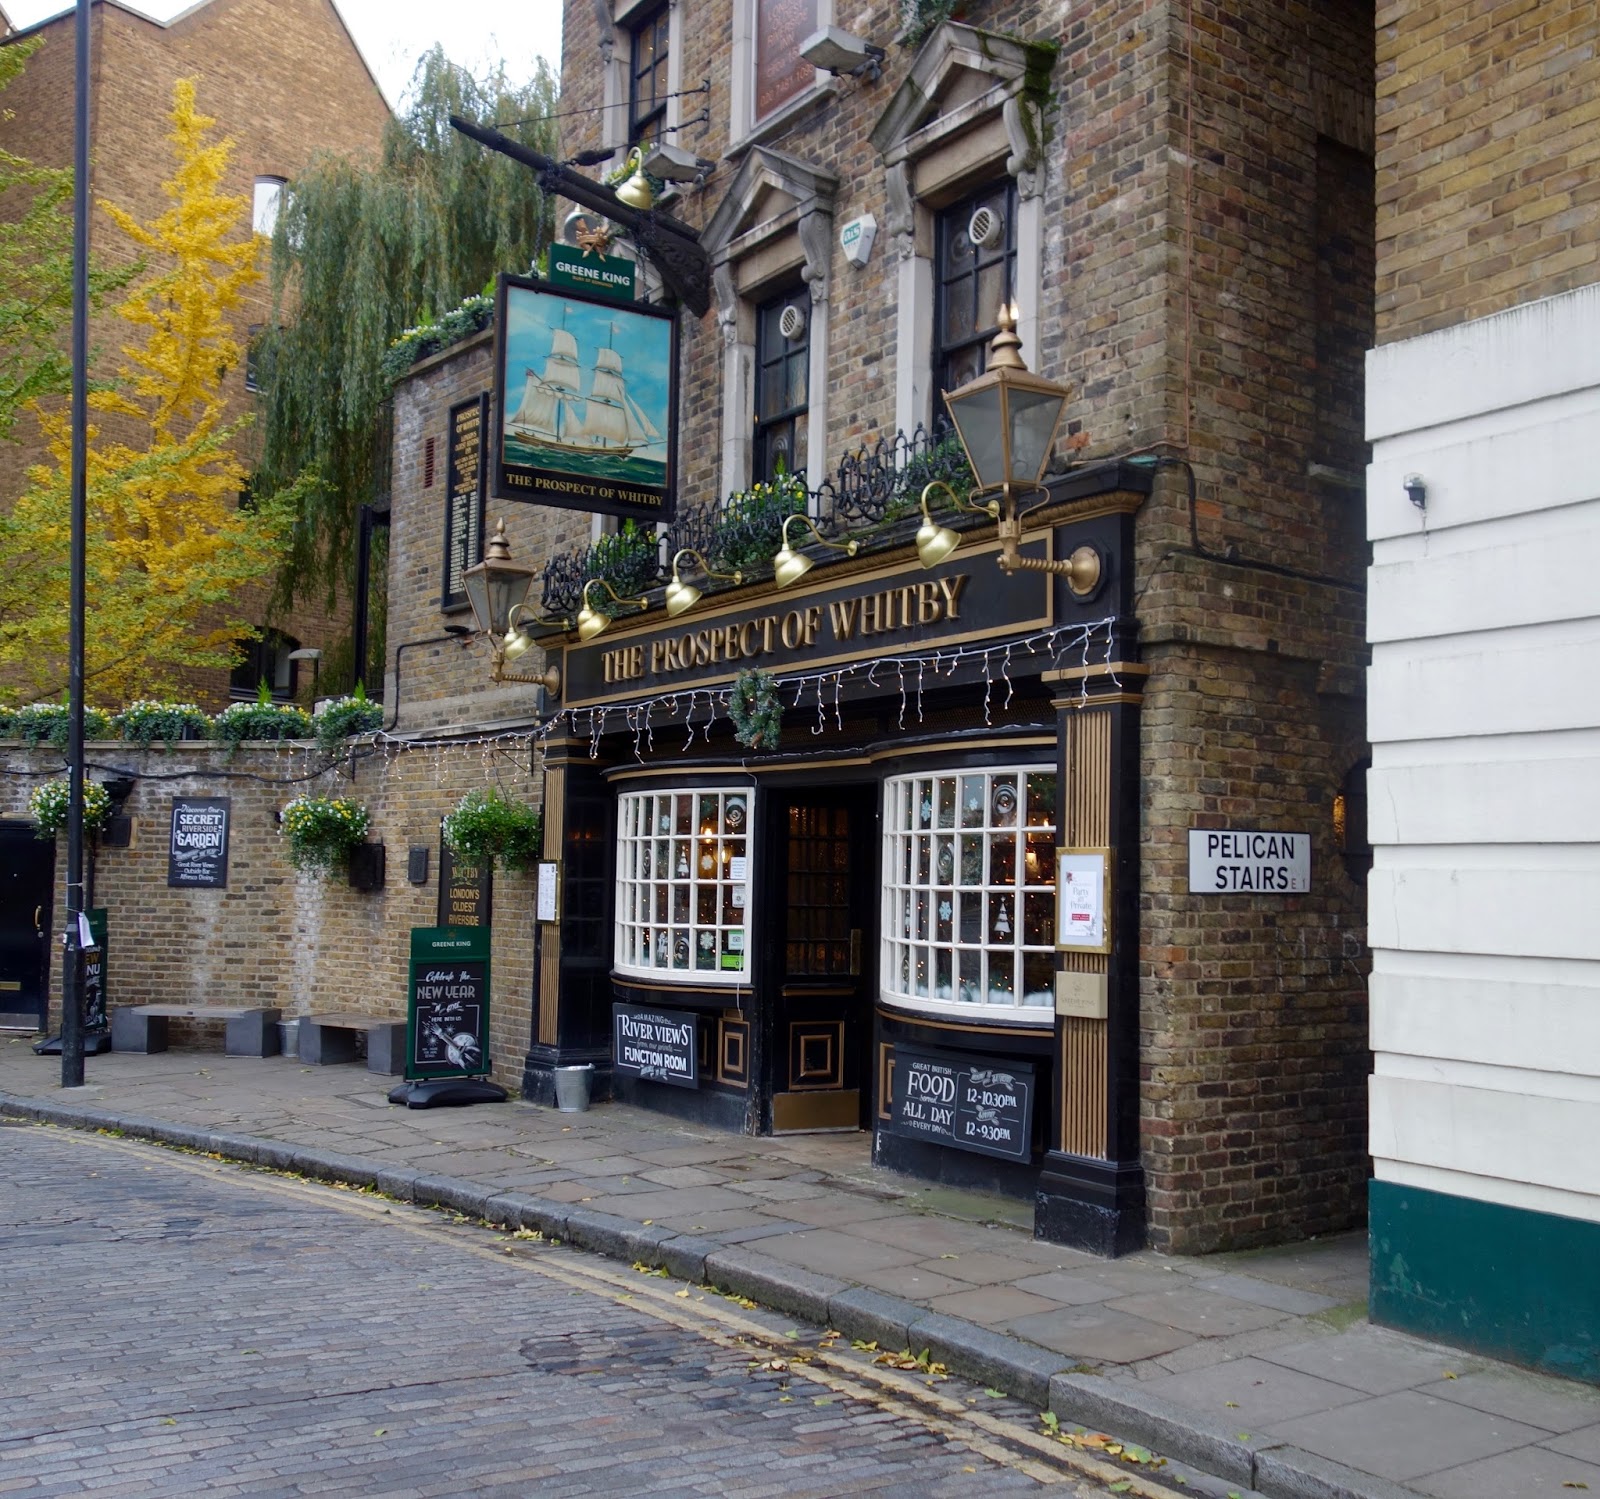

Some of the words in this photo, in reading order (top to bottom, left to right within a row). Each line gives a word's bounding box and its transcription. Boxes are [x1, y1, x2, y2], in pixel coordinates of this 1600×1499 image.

[555, 261, 600, 279] GREENE
[602, 271, 631, 286] KING
[456, 406, 480, 422] PROSPEC
[506, 473, 532, 487] THE
[535, 478, 597, 496] PROSPECT
[599, 487, 615, 498] OF
[618, 490, 663, 506] WHITBY
[601, 644, 646, 684] THE
[651, 615, 780, 673] PROSPECT
[781, 605, 825, 650] OF
[828, 573, 967, 640] WHITBY
[181, 804, 207, 813] Discover
[180, 814, 221, 825] SECRET
[182, 825, 218, 833] RIVERSIDE
[177, 833, 219, 847] GARDEN
[1208, 834, 1295, 859] PELICAN
[1215, 865, 1288, 890] STAIRS
[449, 888, 480, 899] LONDON'S
[452, 901, 476, 912] OLDEST
[448, 914, 480, 926] RIVERSIDE
[85, 953, 99, 964] EW
[86, 964, 100, 976] NU
[417, 986, 443, 1000] NEW
[445, 985, 475, 999] YEAR
[622, 1014, 654, 1040] RIVER
[655, 1024, 688, 1046] VIEWS
[624, 1046, 663, 1067] FUNCTION
[664, 1054, 687, 1072] ROOM
[912, 1062, 930, 1072] GREAT
[931, 1065, 952, 1075] BRITISH
[907, 1070, 955, 1102] FOOD
[902, 1101, 926, 1120] ALL
[931, 1106, 954, 1126] DAY
[912, 1120, 931, 1131] EVERY
[931, 1124, 942, 1133] DAY
